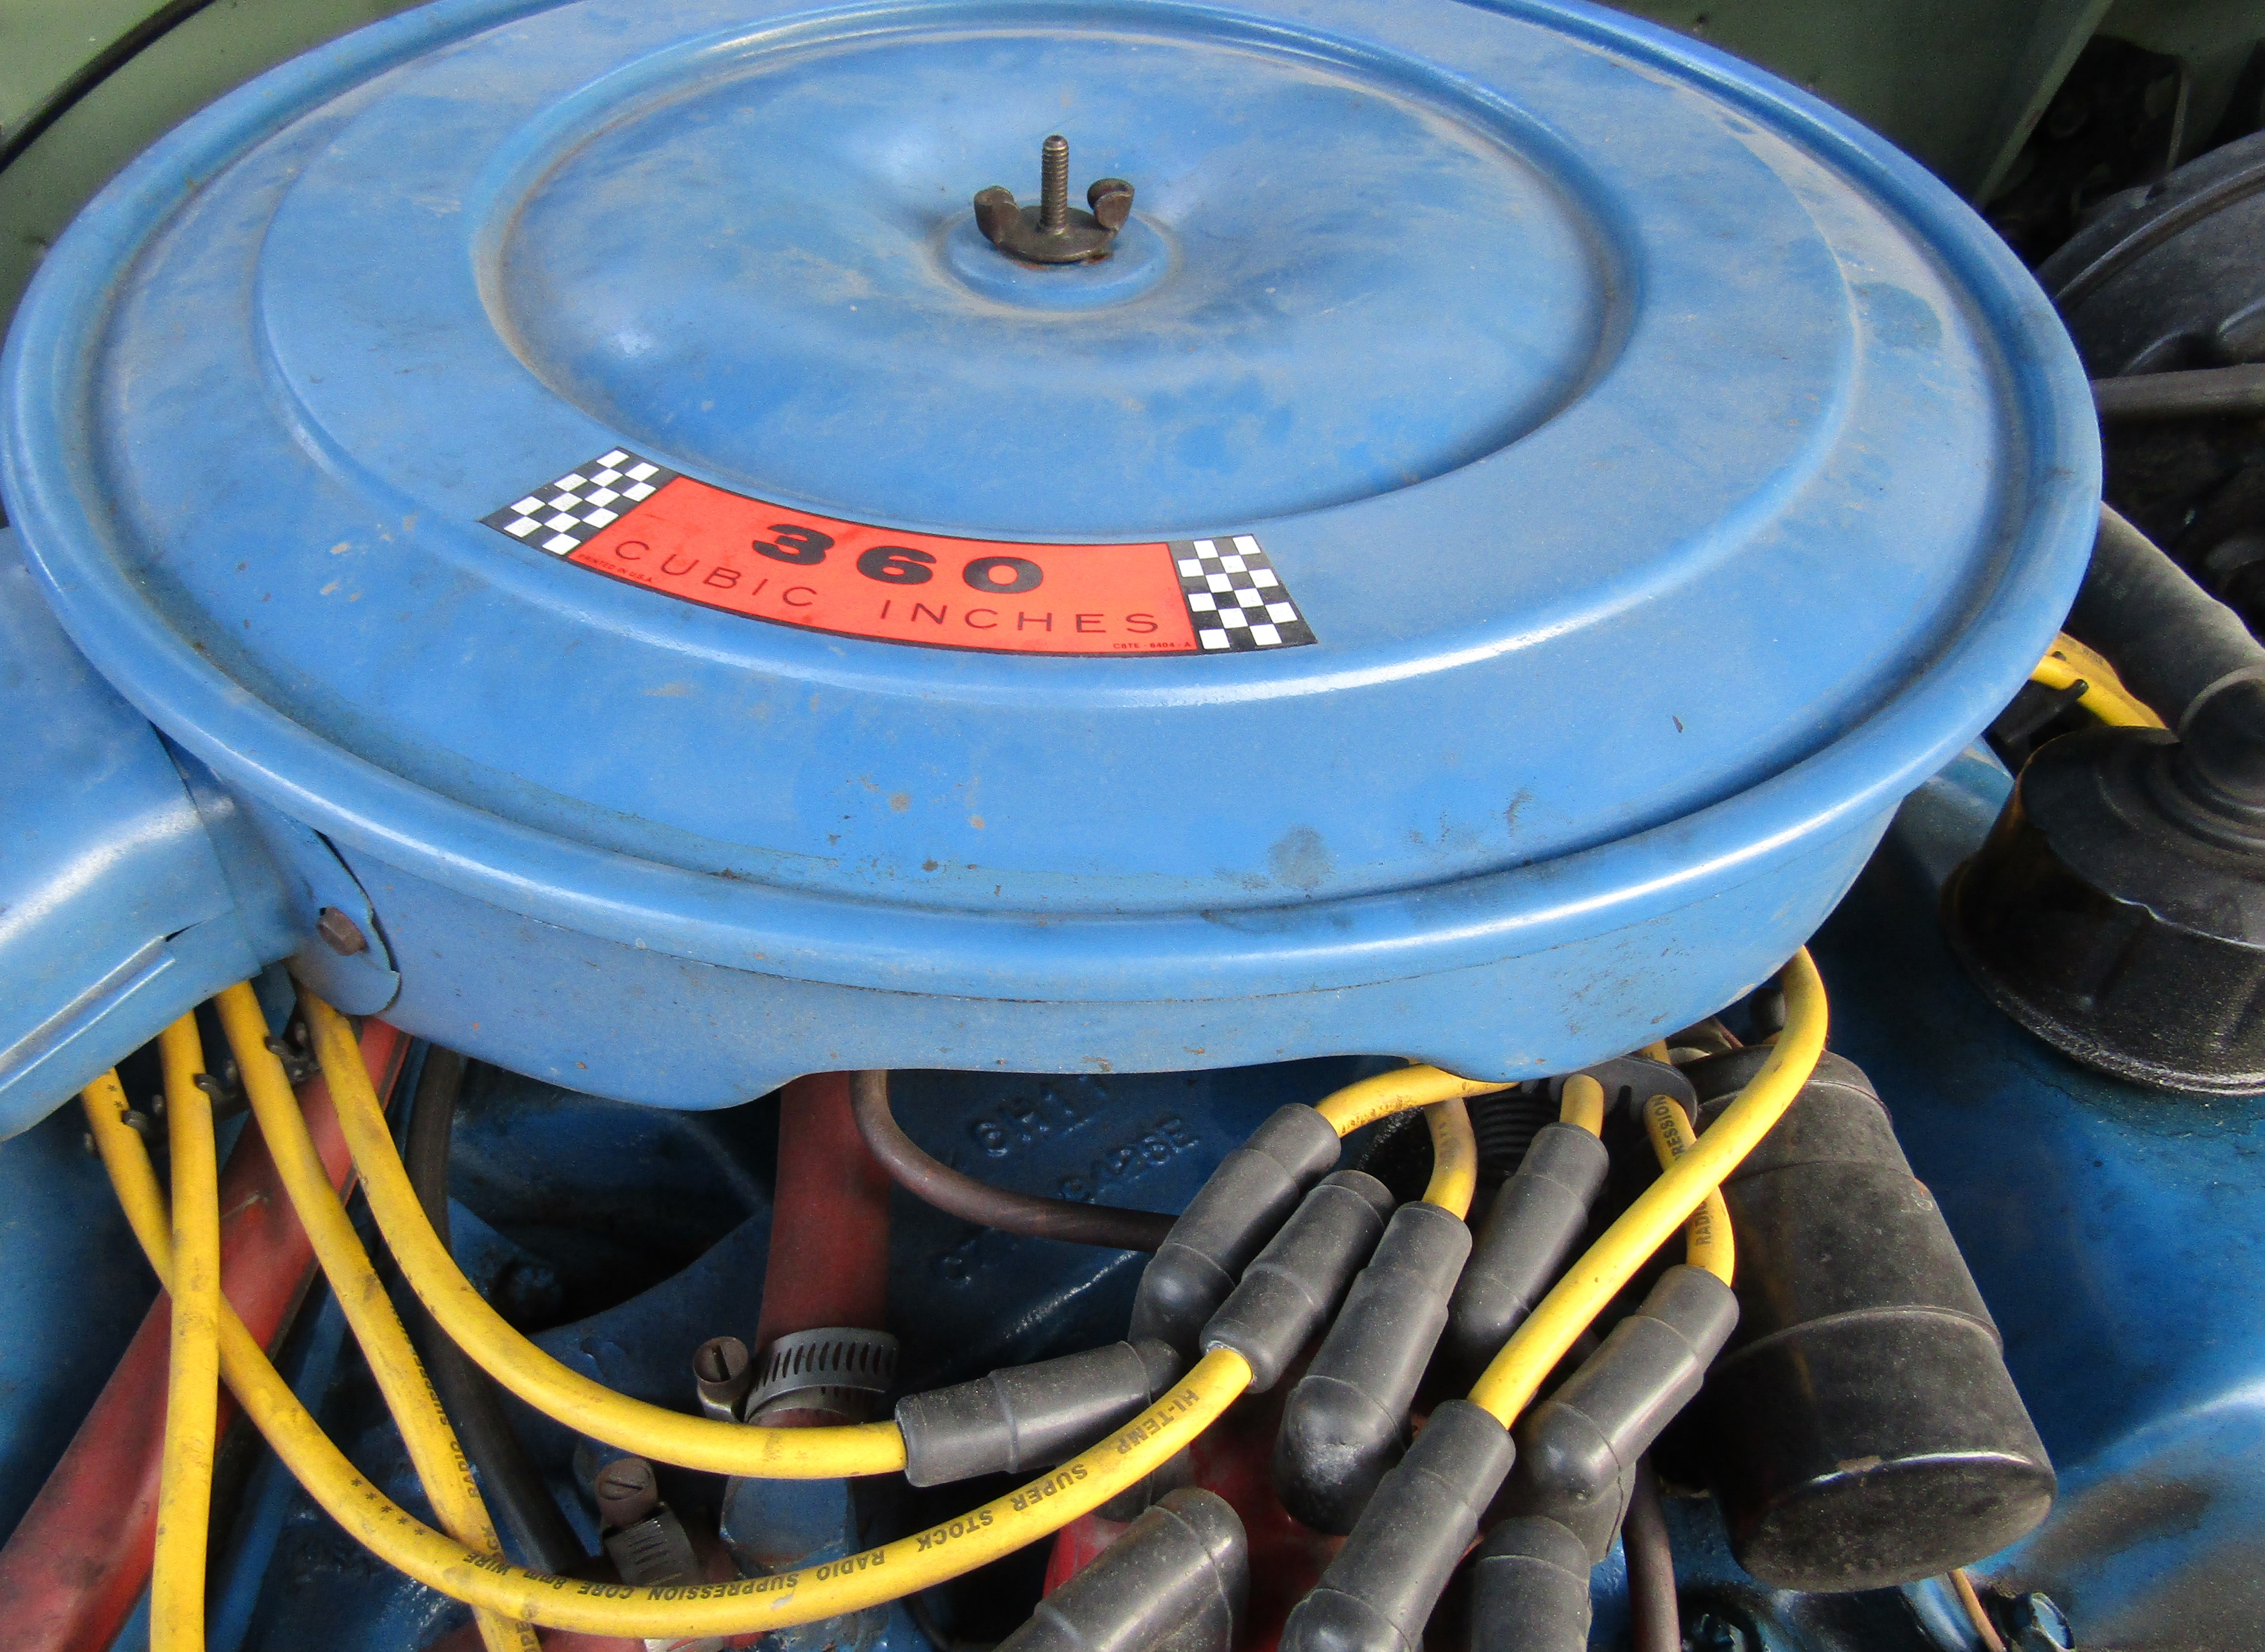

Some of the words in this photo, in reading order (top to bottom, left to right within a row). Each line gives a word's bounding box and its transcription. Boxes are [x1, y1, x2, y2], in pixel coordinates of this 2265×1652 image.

[752, 523, 1044, 593] 360
[616, 541, 817, 606] CUBIC
[882, 599, 1158, 633] INCHES
[1117, 1388, 1199, 1453] HI-TEMP
[1010, 1463, 1088, 1511] SUPER
[918, 1510, 994, 1552] STOCK
[463, 1552, 511, 1576] WIRE
[524, 1571, 568, 1590] 8mm
[817, 1550, 885, 1580] RADIO
[577, 1582, 634, 1599] CORE
[647, 1574, 799, 1600] SUPPRESSION
